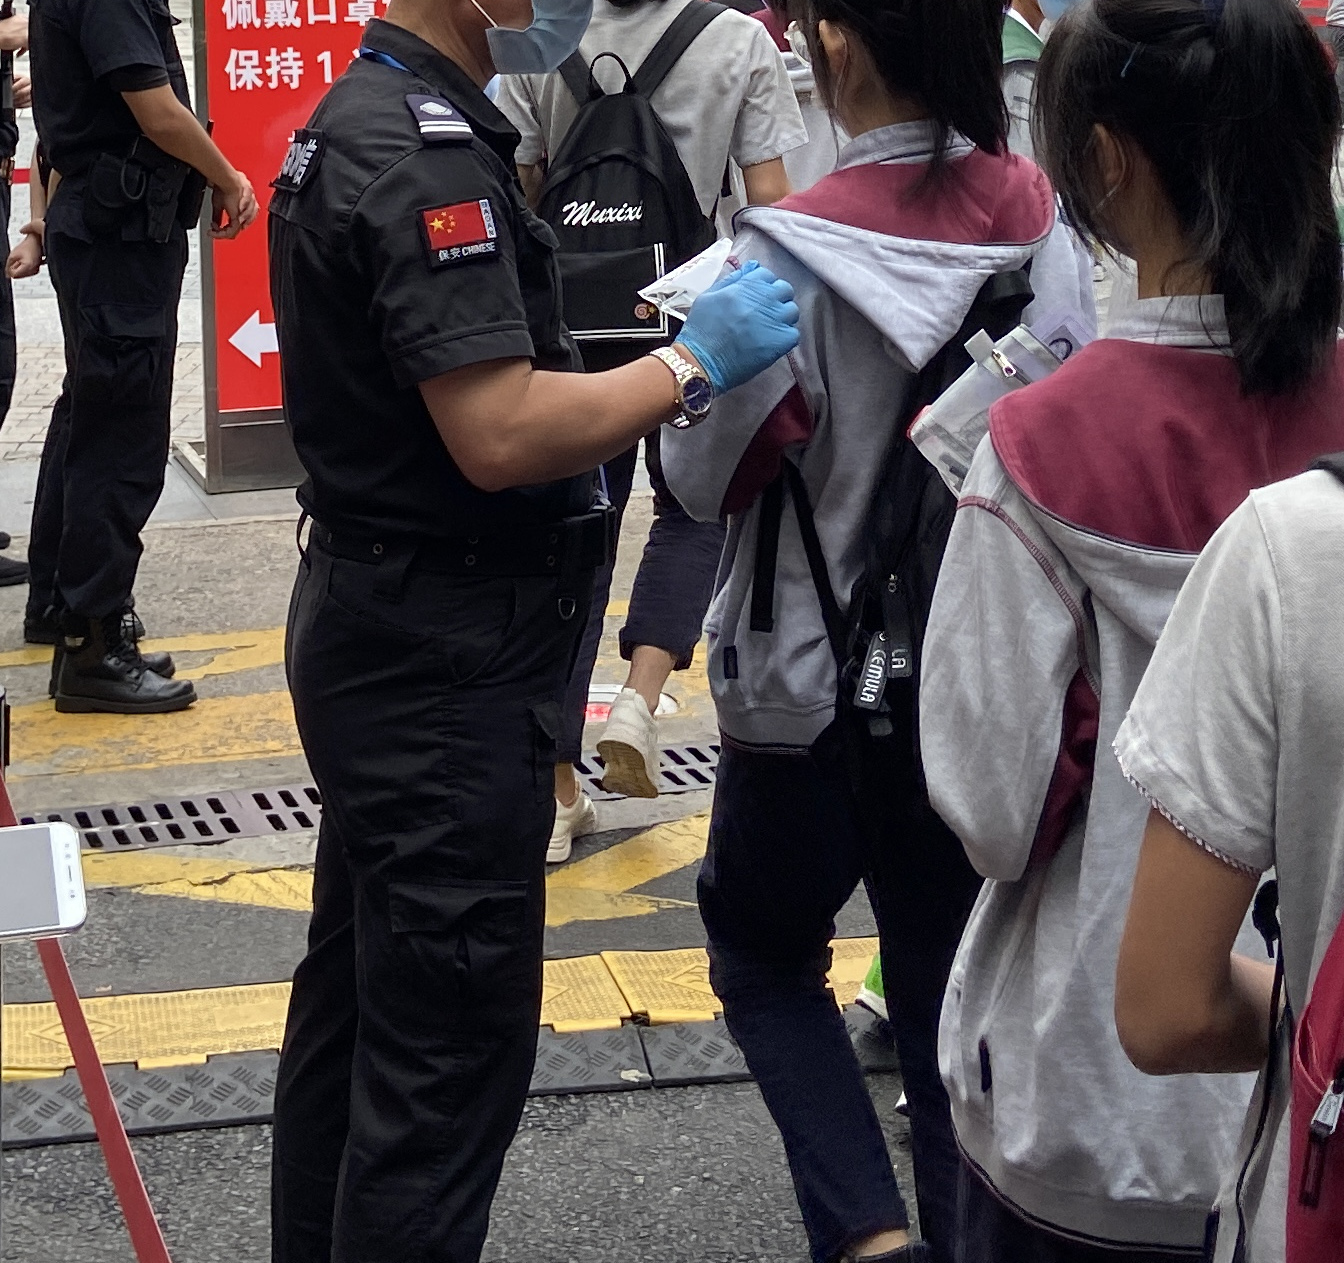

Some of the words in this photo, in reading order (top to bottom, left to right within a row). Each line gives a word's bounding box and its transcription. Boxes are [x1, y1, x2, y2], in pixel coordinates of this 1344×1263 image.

[224, 46, 360, 91] 保持1
[561, 199, 645, 227] Muxixi
[438, 247, 461, 262] 保安
[461, 241, 497, 257] CHINESE
